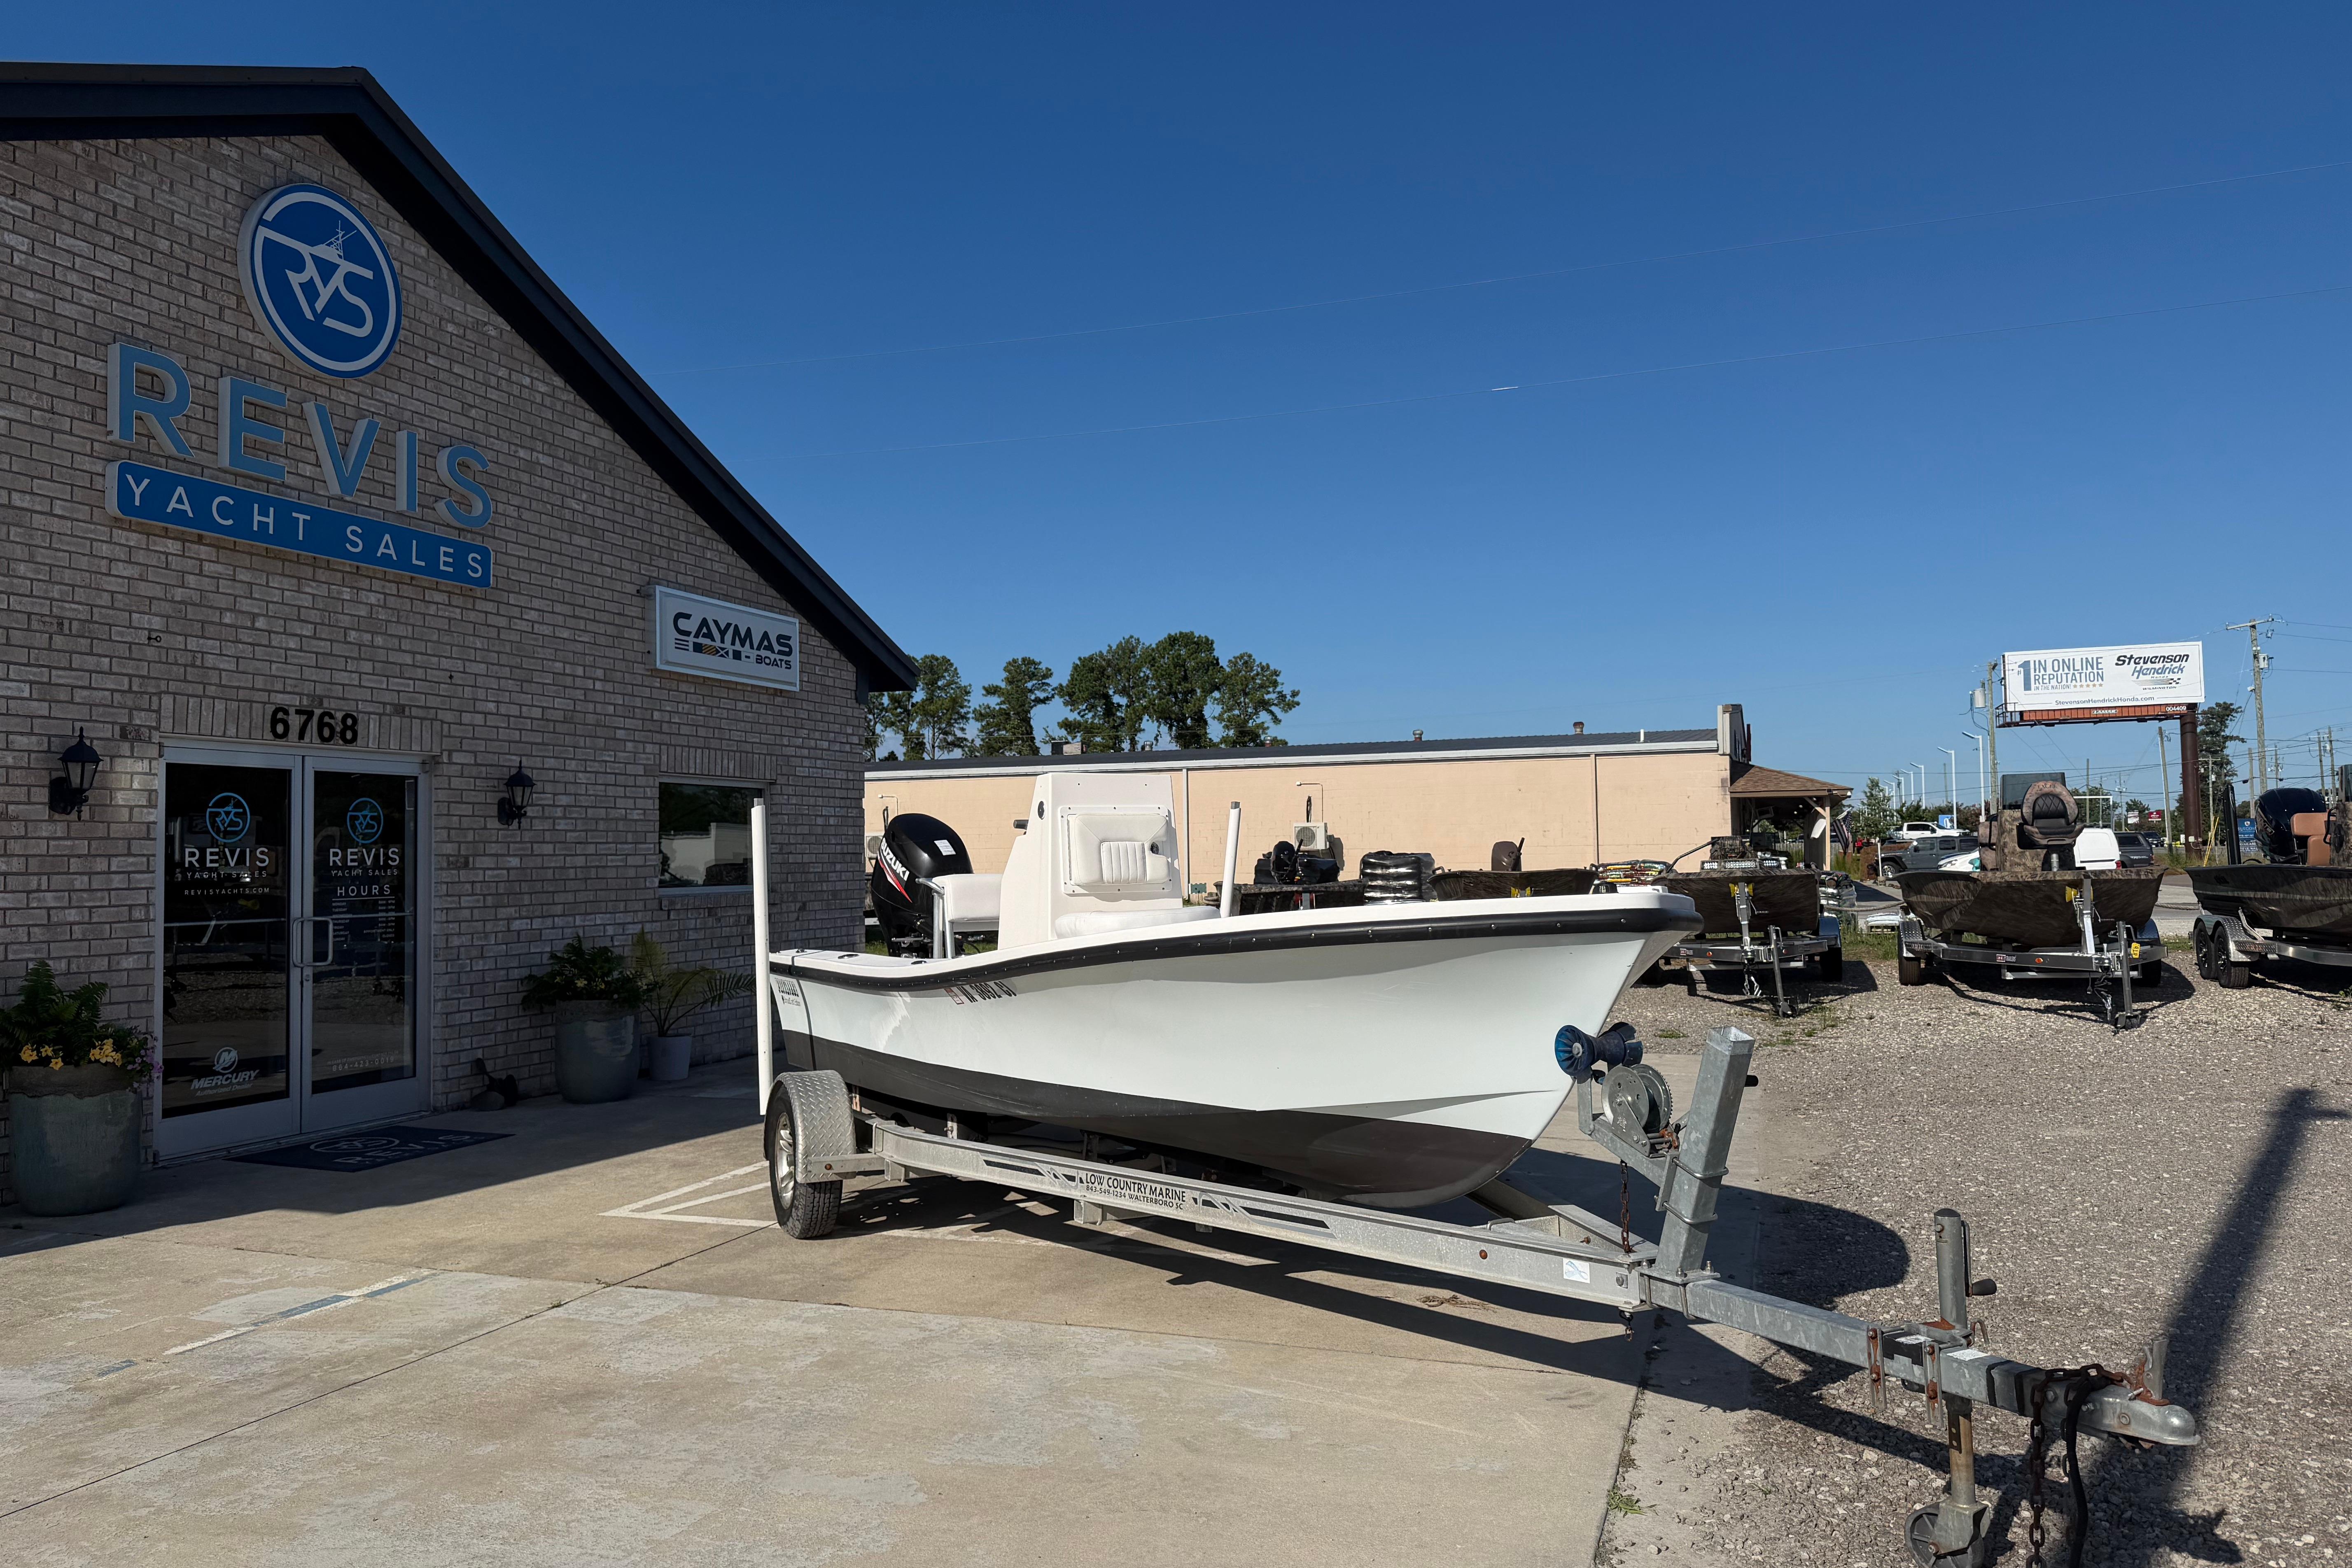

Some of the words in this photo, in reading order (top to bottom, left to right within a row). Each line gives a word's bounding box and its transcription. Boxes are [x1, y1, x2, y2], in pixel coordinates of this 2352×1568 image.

[108, 342, 493, 529] REVIS
[125, 474, 311, 541] YACHT
[345, 525, 483, 578] SALES
[673, 612, 793, 657] CAYMAS
[755, 654, 792, 670] BOATS
[2033, 660, 2047, 673] IN
[2052, 657, 2104, 672] ONLINE
[2115, 654, 2189, 666] Stevenson
[2034, 671, 2104, 685] REPUTATION
[2131, 663, 2185, 679] Hendrick
[2055, 696, 2155, 705] StevensonHendrickHonda.com
[270, 706, 358, 744] 6768
[185, 847, 269, 867] REVIS
[330, 848, 399, 866] REVIS
[881, 837, 910, 882] SUZUKI
[337, 884, 390, 896] HOURS
[332, 1056, 394, 1071] 864-423-0019
[191, 1069, 260, 1090] MERCURY
[195, 1086, 231, 1097] Authorized
[1086, 1173, 1104, 1186] LOW
[1107, 1177, 1148, 1195] COUNTRY
[1149, 1185, 1186, 1202] MARINE
[1086, 1185, 1126, 1198] 843-549-1234
[1128, 1193, 1174, 1208] WALTERBORO
